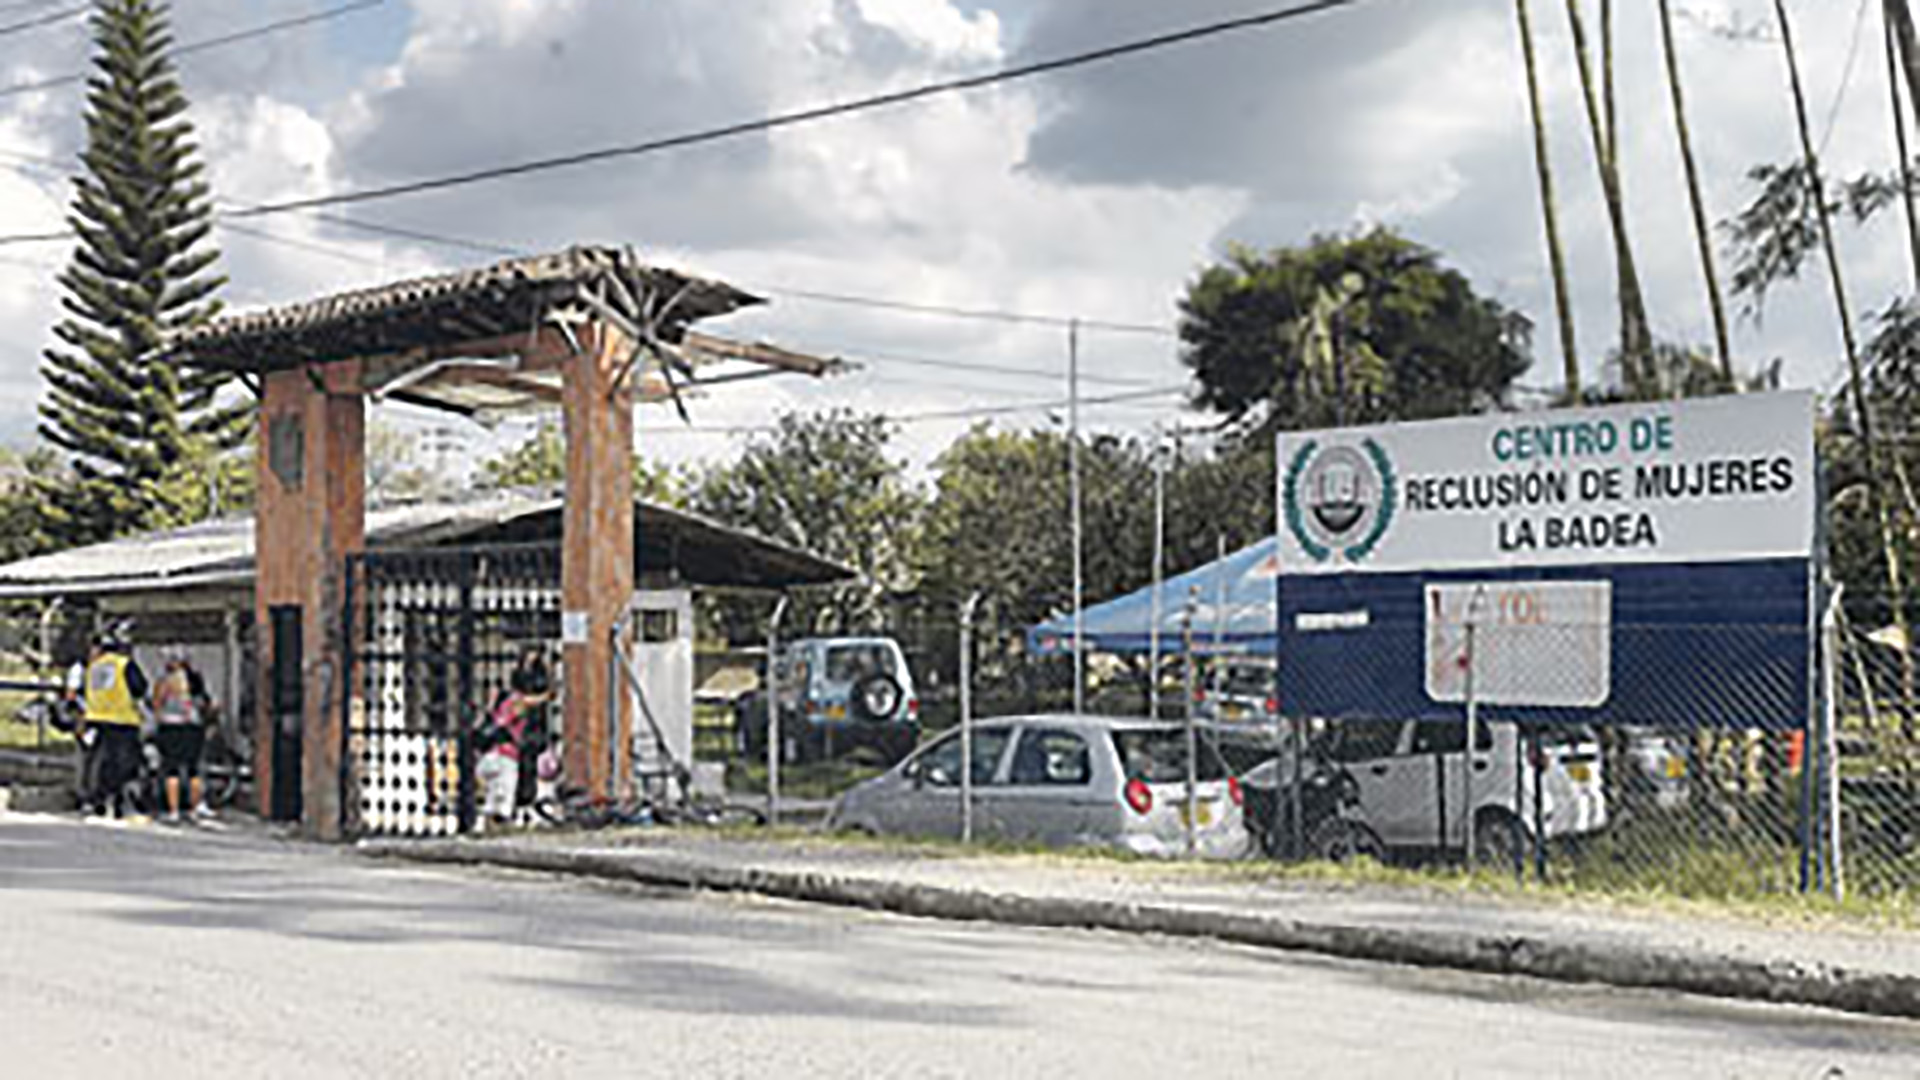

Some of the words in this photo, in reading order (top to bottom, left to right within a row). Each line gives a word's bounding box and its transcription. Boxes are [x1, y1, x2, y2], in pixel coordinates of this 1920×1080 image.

[1493, 420, 1617, 461] CENTRO
[1630, 416, 1673, 451] DE
[1405, 461, 1567, 510] RECLUSIÓN
[1580, 468, 1621, 501] DE
[1636, 457, 1793, 497] MUJERES
[1499, 520, 1536, 551] LA
[1545, 513, 1656, 548] BADEA
